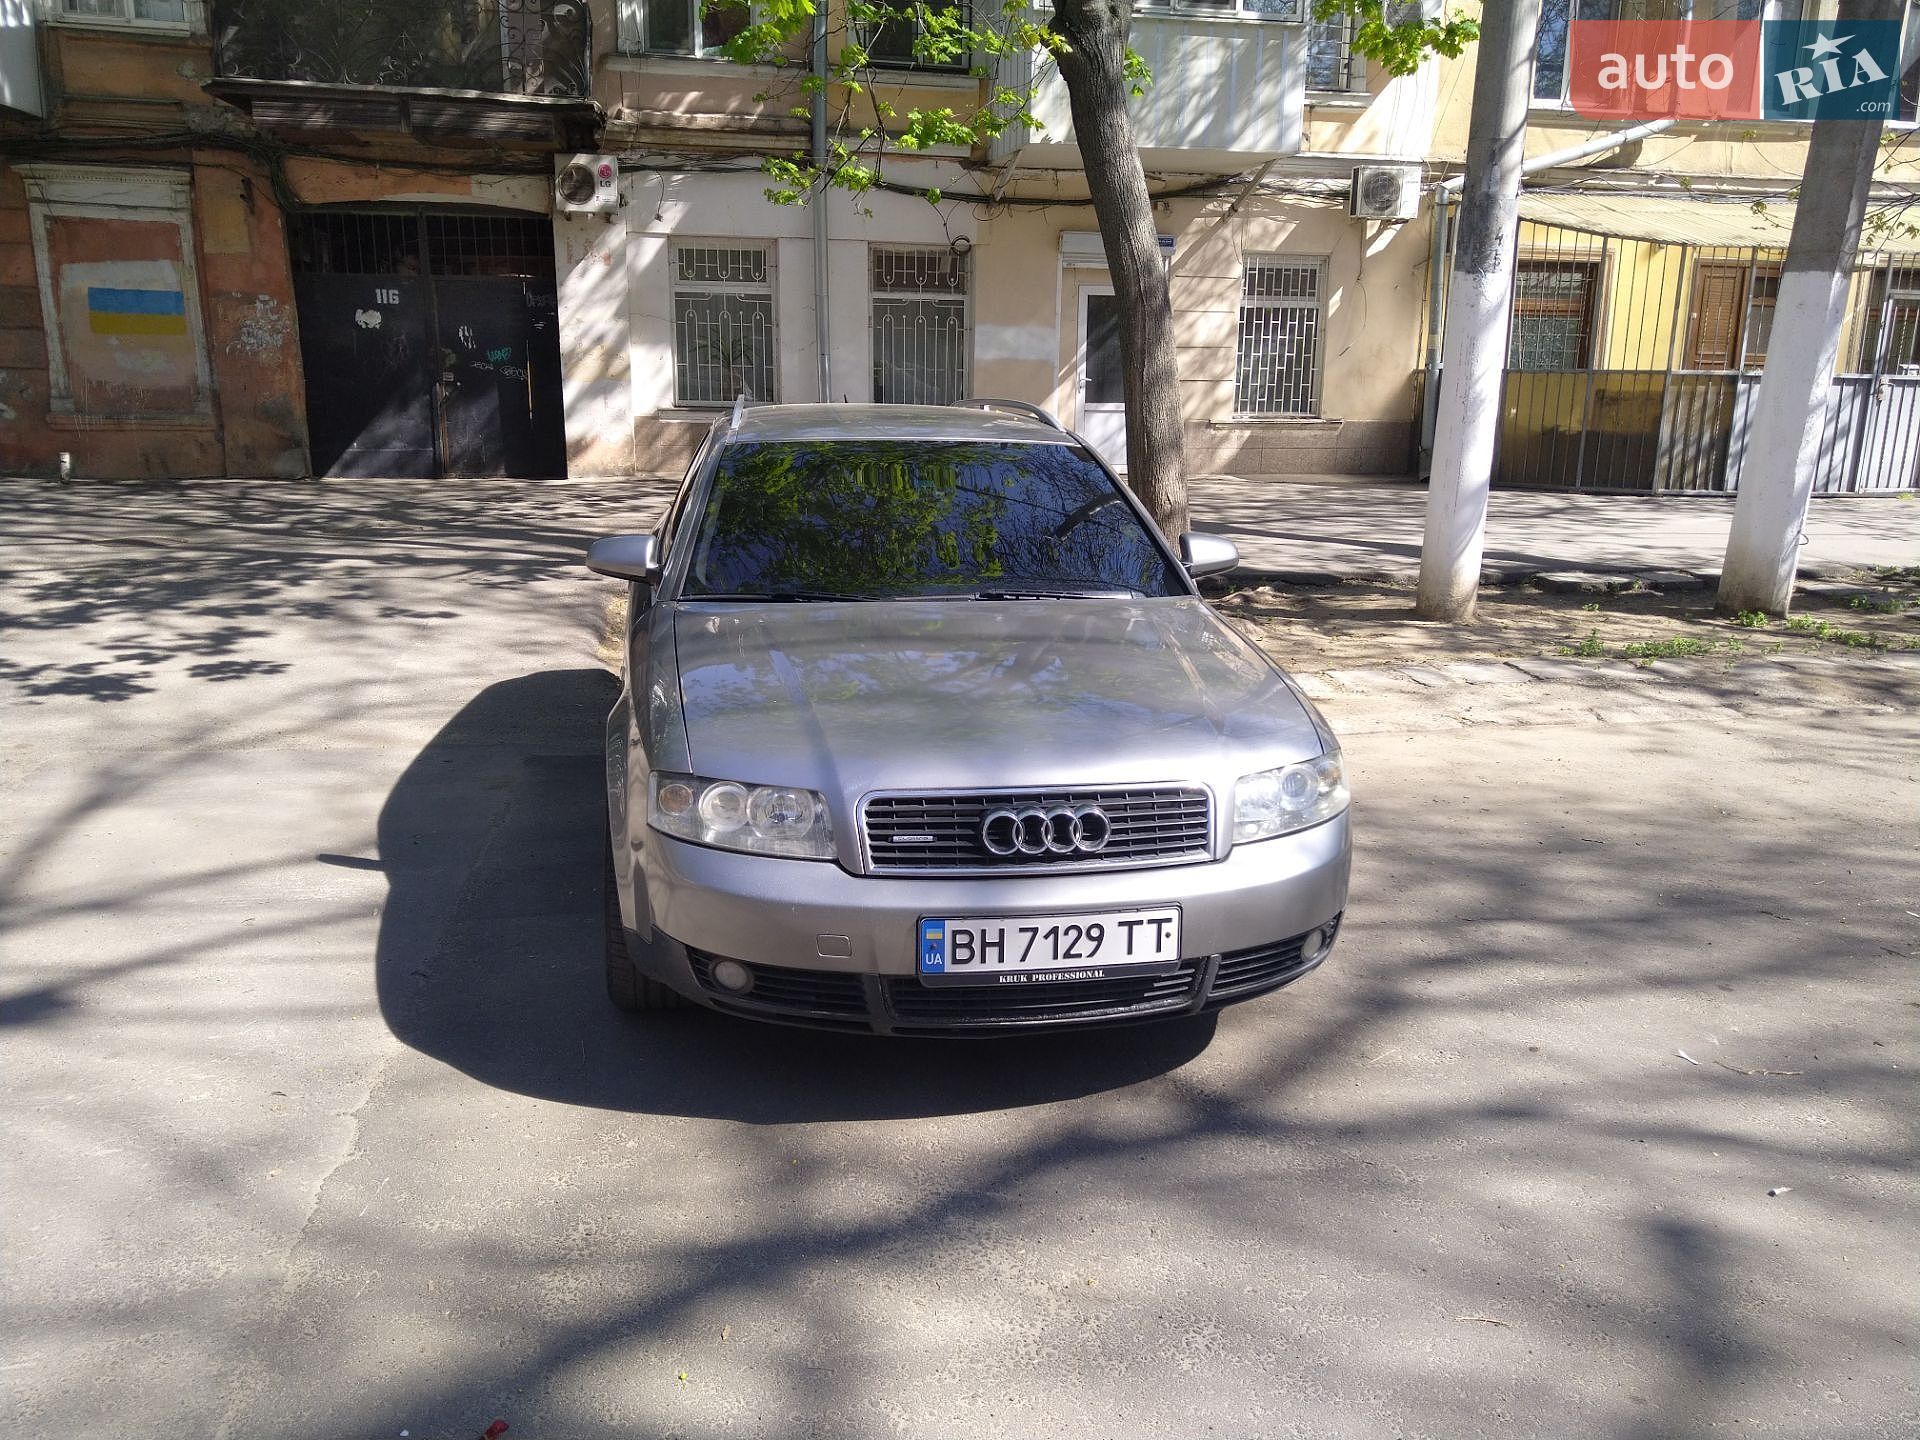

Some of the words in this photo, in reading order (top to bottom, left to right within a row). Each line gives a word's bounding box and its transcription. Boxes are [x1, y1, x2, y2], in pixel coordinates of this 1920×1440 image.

[600, 180, 612, 188] LG
[951, 928, 1005, 965] BH
[1018, 923, 1105, 963] 7129
[1117, 917, 1173, 956] TT
[925, 952, 943, 966] UA
[999, 974, 1028, 983] KRUK
[1032, 970, 1105, 982] PROFESSIONAL
